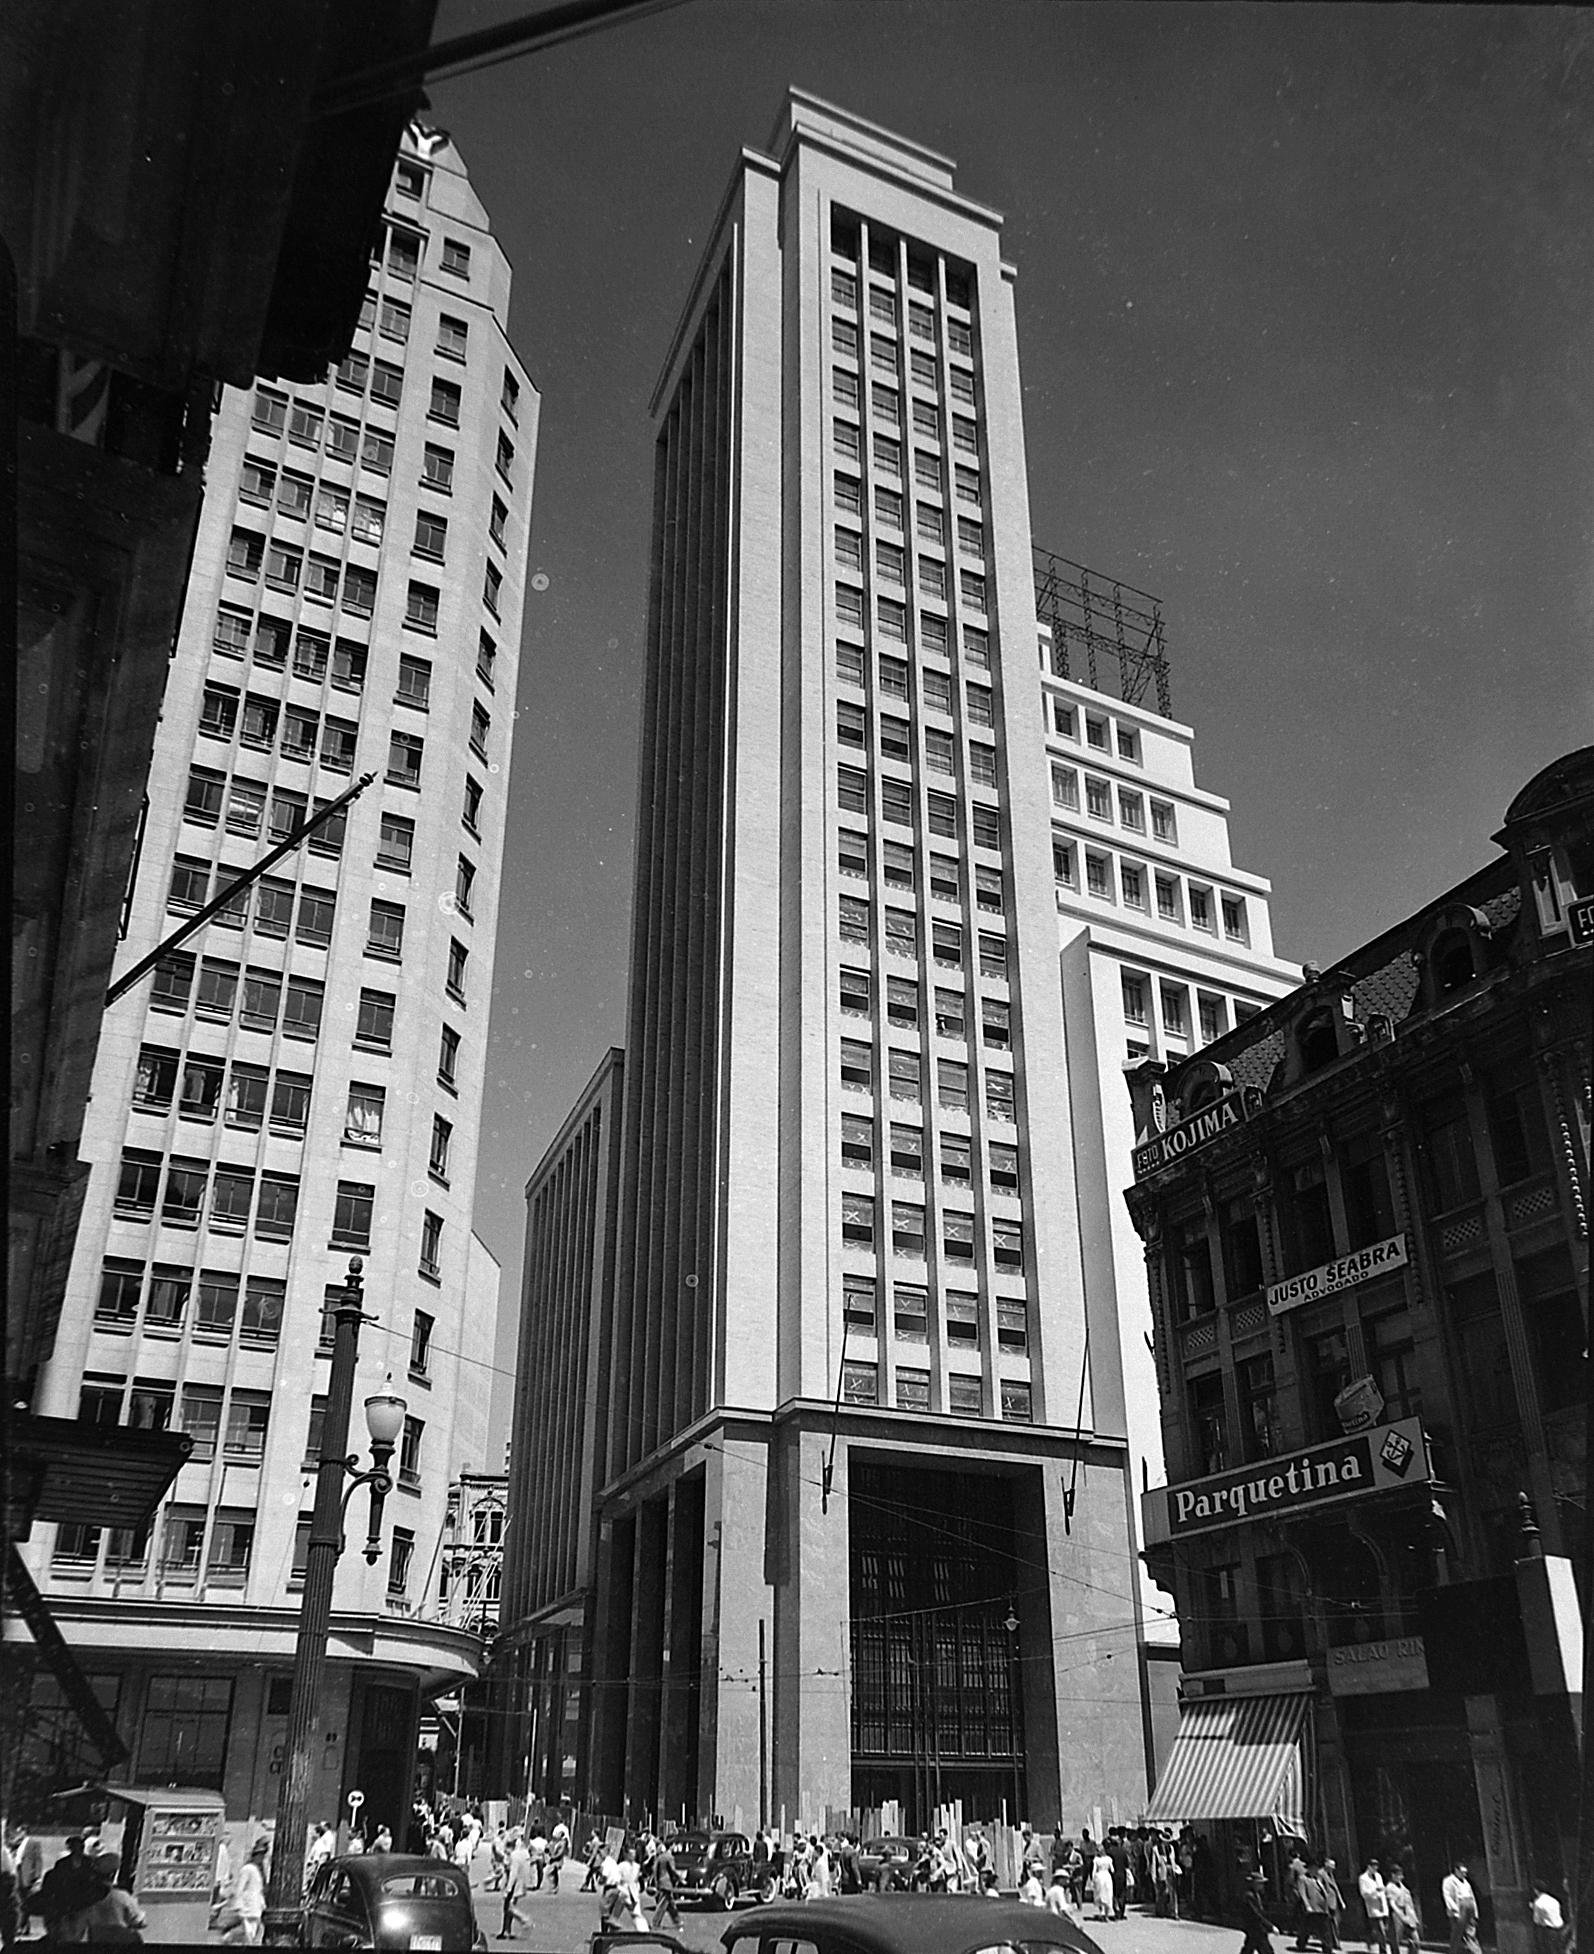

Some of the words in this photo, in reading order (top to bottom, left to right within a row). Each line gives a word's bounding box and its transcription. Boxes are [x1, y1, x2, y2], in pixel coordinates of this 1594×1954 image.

[1136, 1145, 1159, 1169] FOTO
[1161, 1102, 1239, 1161] KOJIMA
[1269, 1274, 1318, 1306] JUSTO
[1326, 1241, 1400, 1283] SEABRA
[1175, 1455, 1362, 1523] Parquetina
